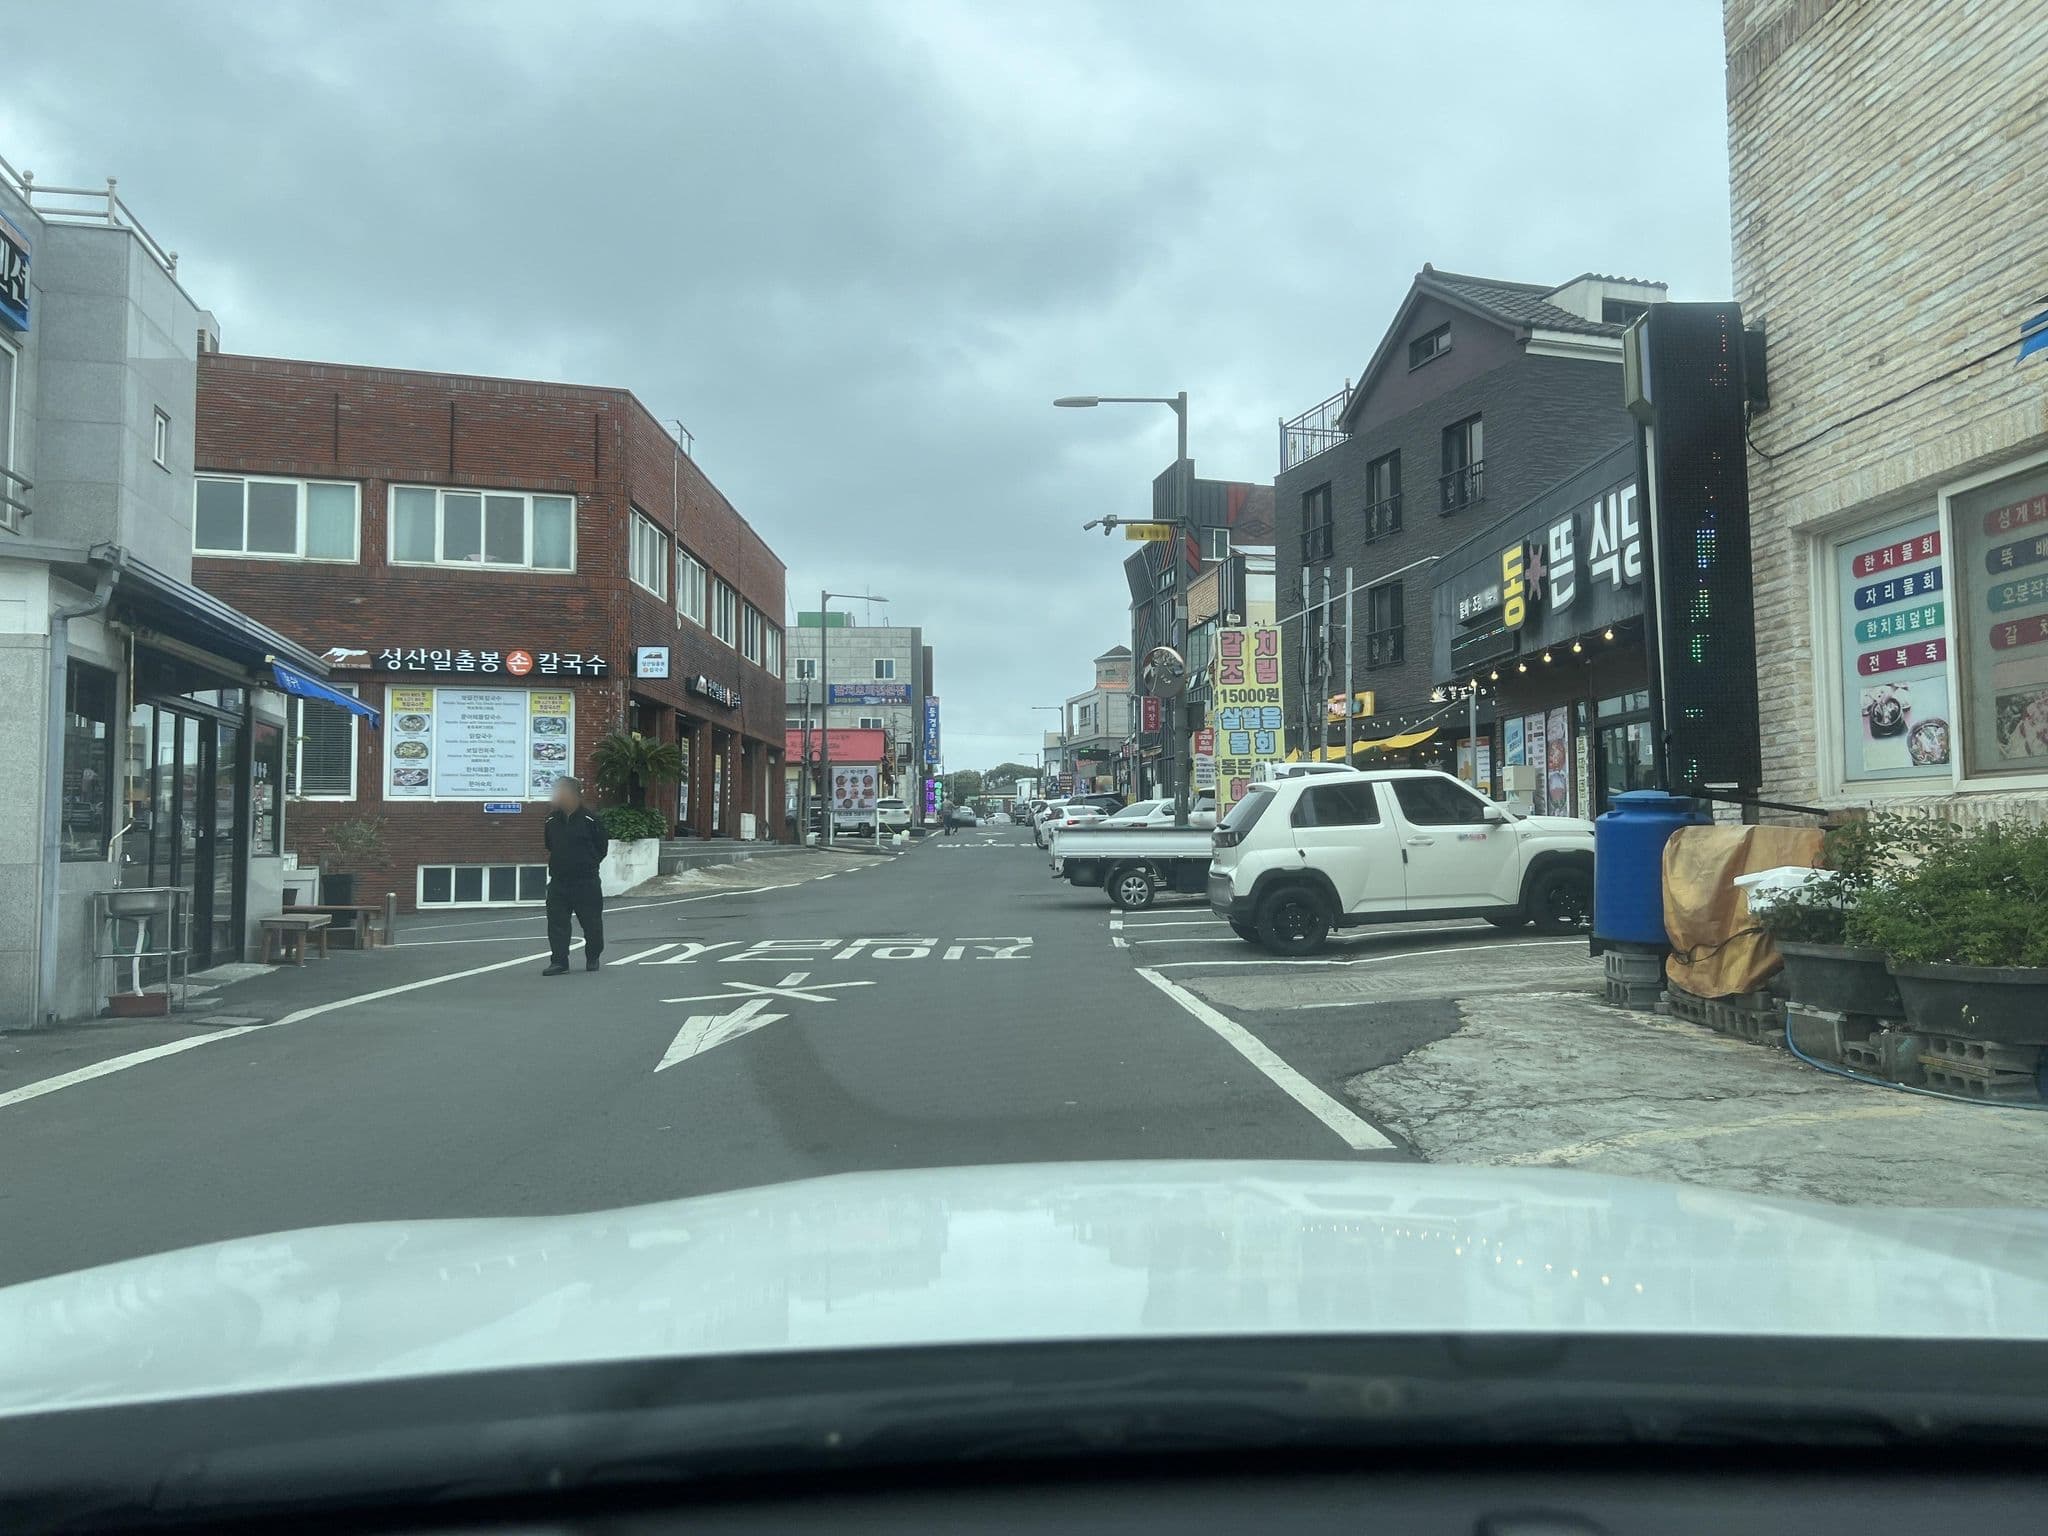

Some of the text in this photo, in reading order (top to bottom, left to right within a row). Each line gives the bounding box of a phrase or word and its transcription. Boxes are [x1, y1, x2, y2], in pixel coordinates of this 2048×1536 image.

[1864, 535, 1933, 572] 한치물회
[1866, 572, 1934, 604] 자리물회
[2003, 577, 2048, 605] 오분작
[1866, 607, 1936, 638] 한치회덮밥
[1220, 629, 1278, 657] 갈치
[378, 648, 607, 676] 성산일출봉 손 칼국수
[1220, 657, 1279, 684] 조림
[1869, 643, 1937, 672] 전복죽
[1220, 687, 1280, 703] 15000원
[1220, 706, 1282, 730] 살얼음
[1229, 730, 1276, 756] 물회
[1221, 758, 1252, 776] 동뜬
[605, 936, 1033, 966] 진입금지
